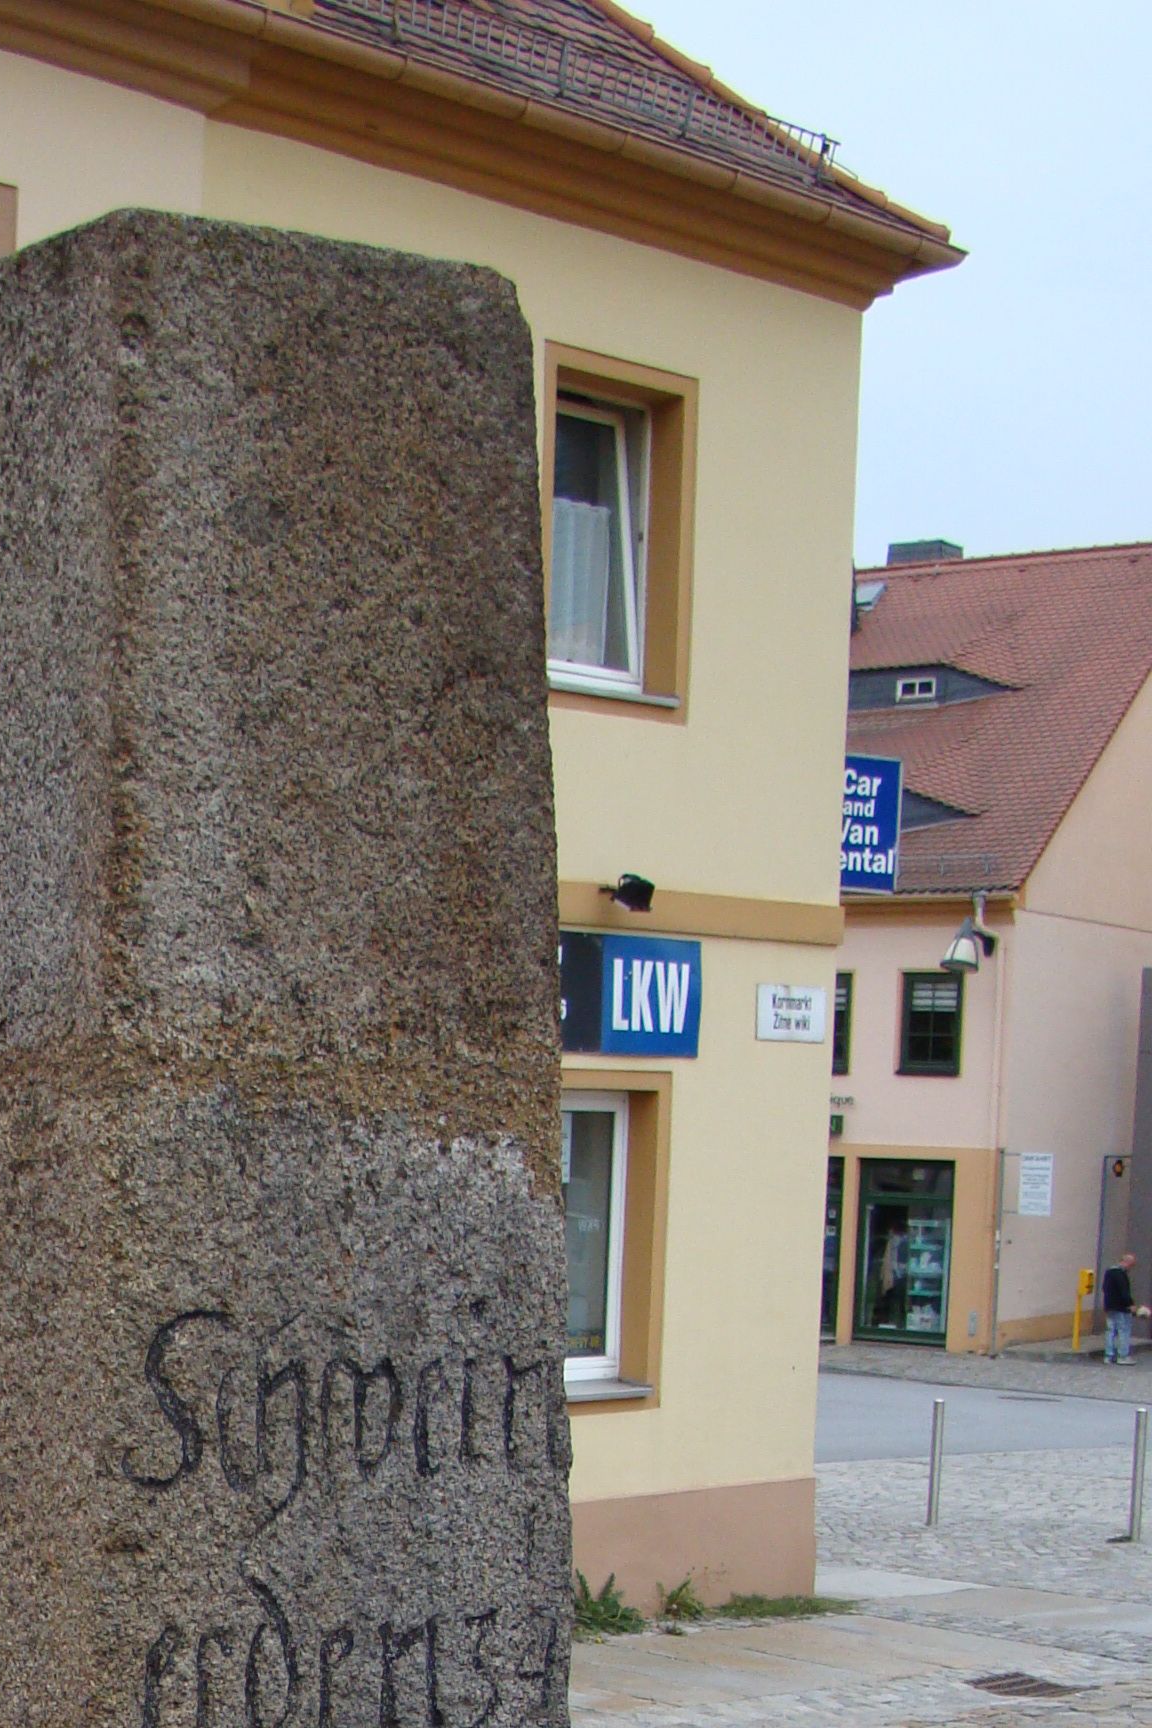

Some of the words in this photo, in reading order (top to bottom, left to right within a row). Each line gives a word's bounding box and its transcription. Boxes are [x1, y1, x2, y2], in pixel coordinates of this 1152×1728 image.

[843, 768, 882, 798] Car
[842, 798, 876, 818] and
[612, 957, 691, 1035] LKW
